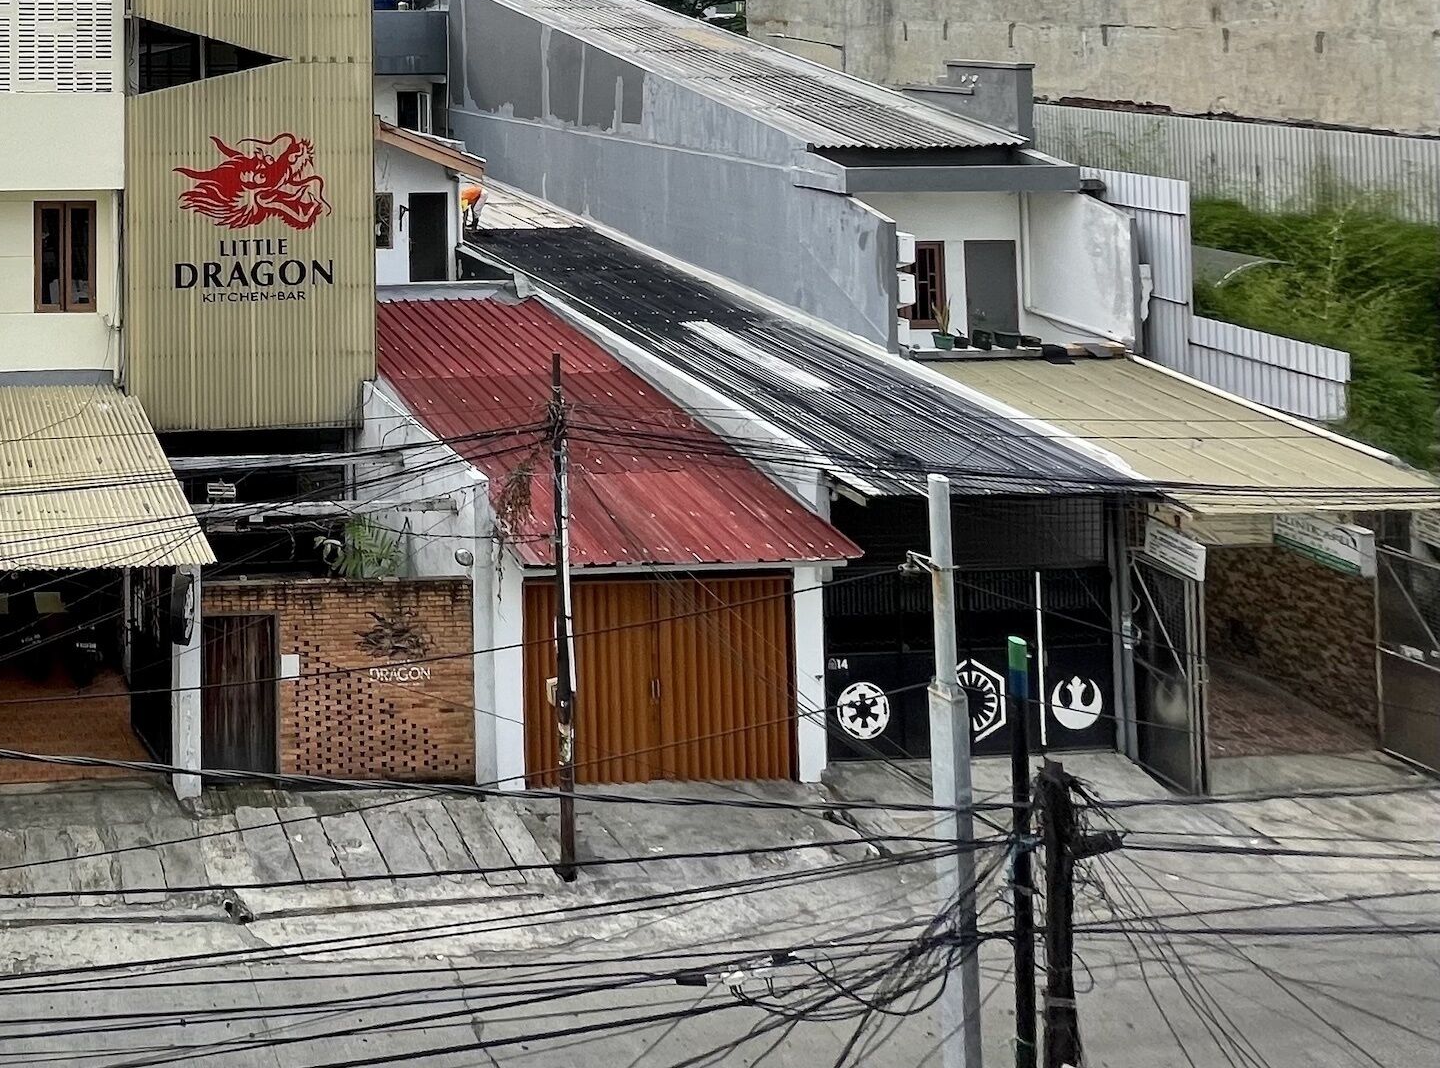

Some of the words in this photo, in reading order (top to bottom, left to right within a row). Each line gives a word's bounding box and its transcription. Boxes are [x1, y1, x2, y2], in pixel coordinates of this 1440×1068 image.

[220, 238, 288, 257] LITTLE
[174, 259, 333, 290] DRAGON
[369, 666, 432, 683] DRAGON
